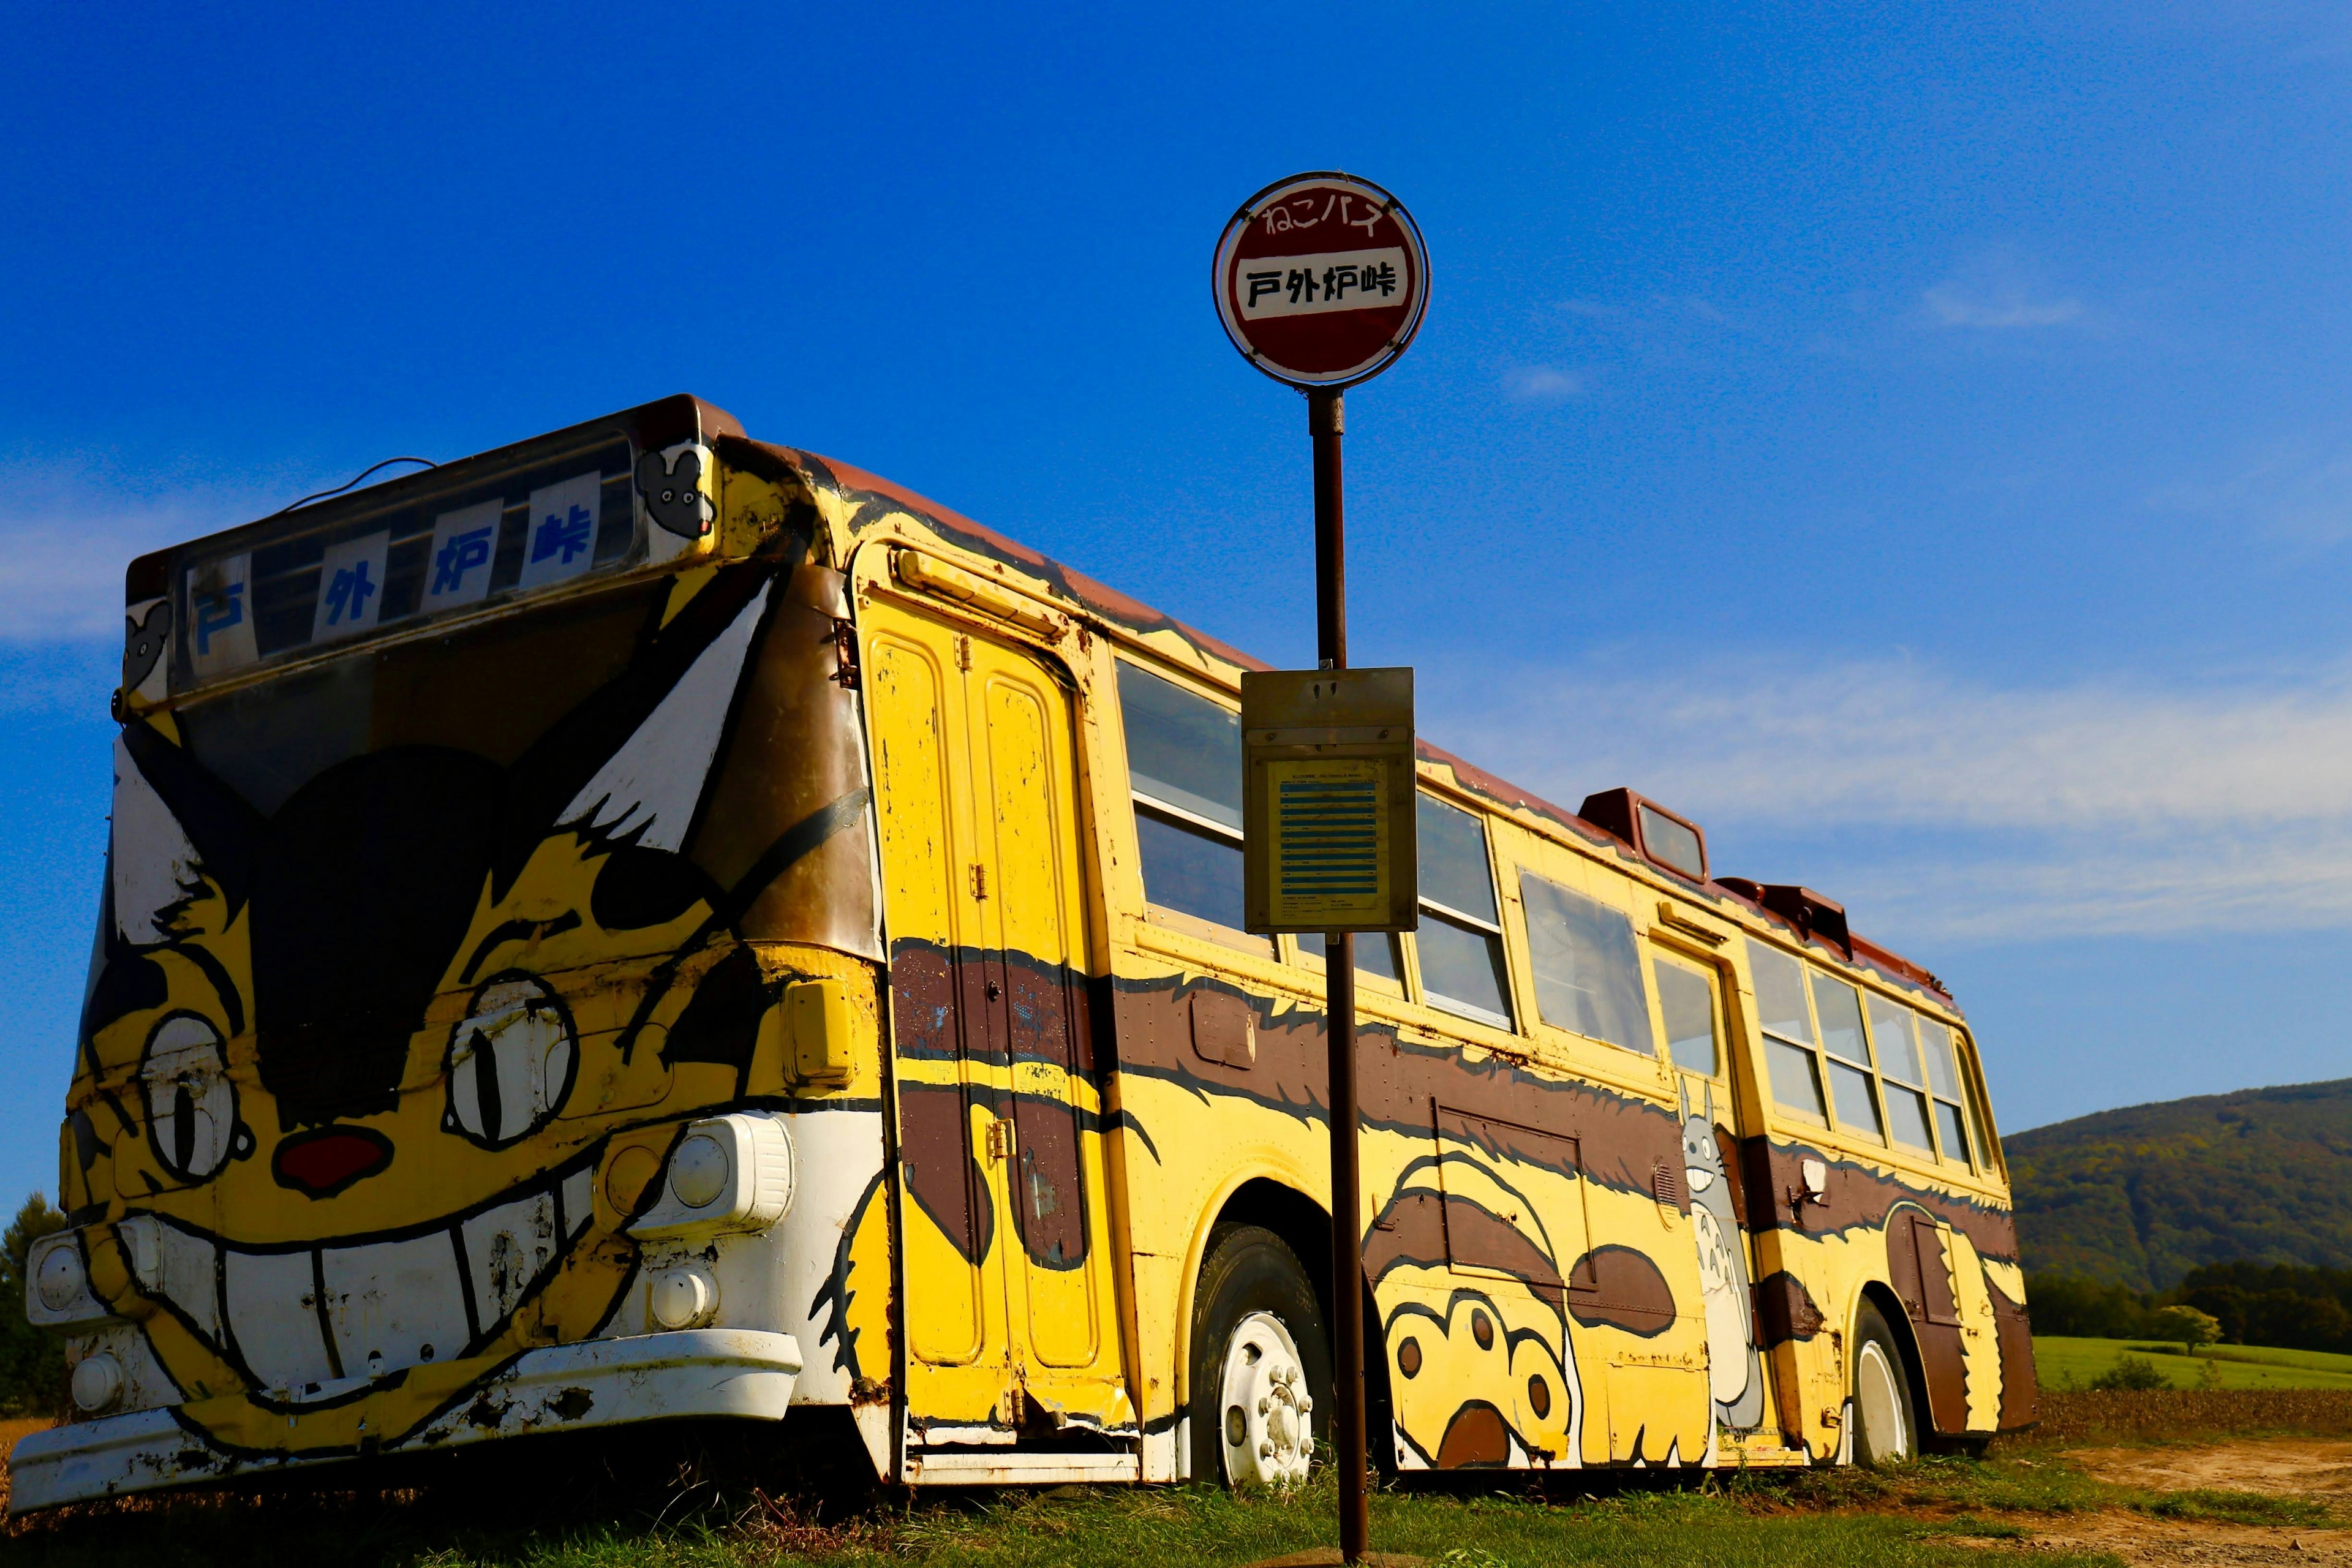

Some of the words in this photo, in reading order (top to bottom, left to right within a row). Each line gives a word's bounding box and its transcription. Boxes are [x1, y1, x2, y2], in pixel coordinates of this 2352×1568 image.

[1262, 194, 1383, 238] ねこバス
[1246, 261, 1396, 308] 戸外炉峠
[194, 503, 592, 656] 戸外炉峠
